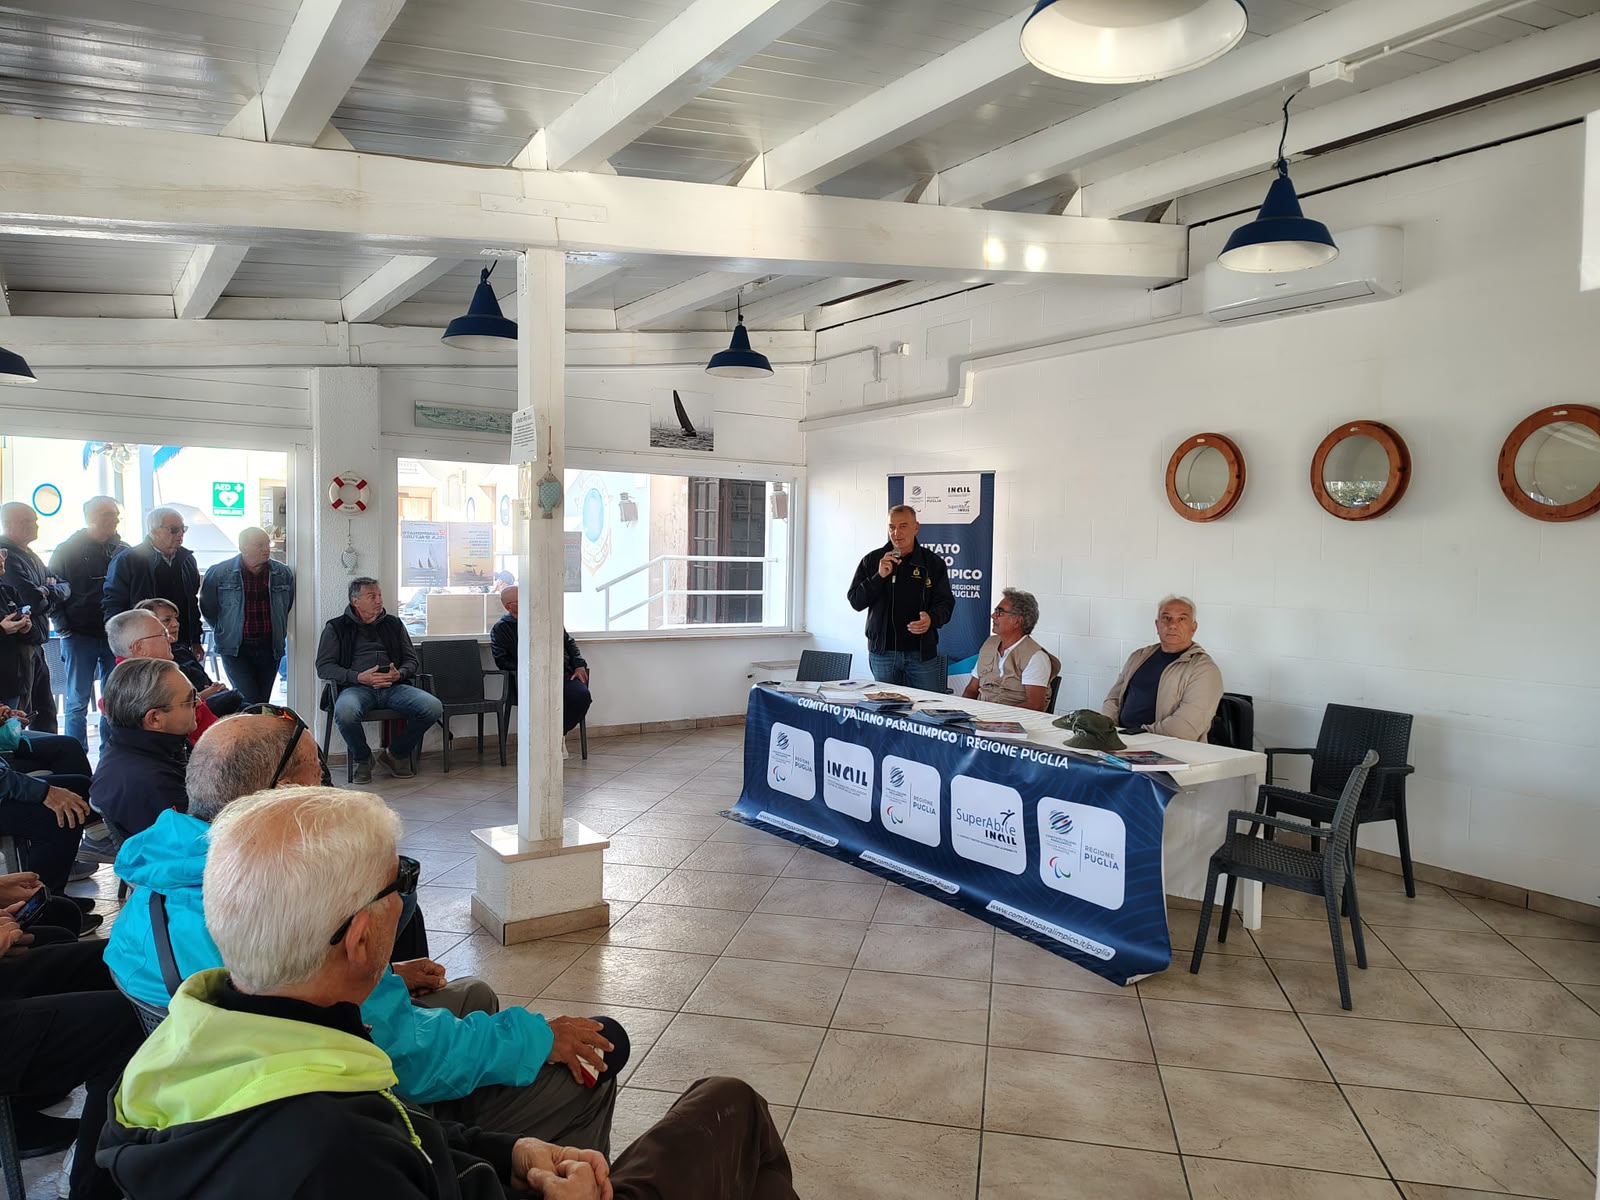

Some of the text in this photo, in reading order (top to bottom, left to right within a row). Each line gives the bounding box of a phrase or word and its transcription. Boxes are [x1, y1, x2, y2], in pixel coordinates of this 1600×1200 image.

[215, 483, 231, 491] AED
[797, 697, 1069, 769] COMITATO ITALIANO PARALIMPICO REGIONE PUGLIA
[795, 761, 813, 773] PUGLIA
[827, 759, 868, 787] INAIL
[912, 801, 936, 815] PUGLIA
[956, 808, 1016, 837] SuperAbile
[985, 829, 1017, 846] INAIL
[1084, 845, 1115, 860] REGIONE
[1084, 852, 1120, 871] PUGLIA
[990, 903, 1111, 958] www.comitatoparalimpico.it/puglia
